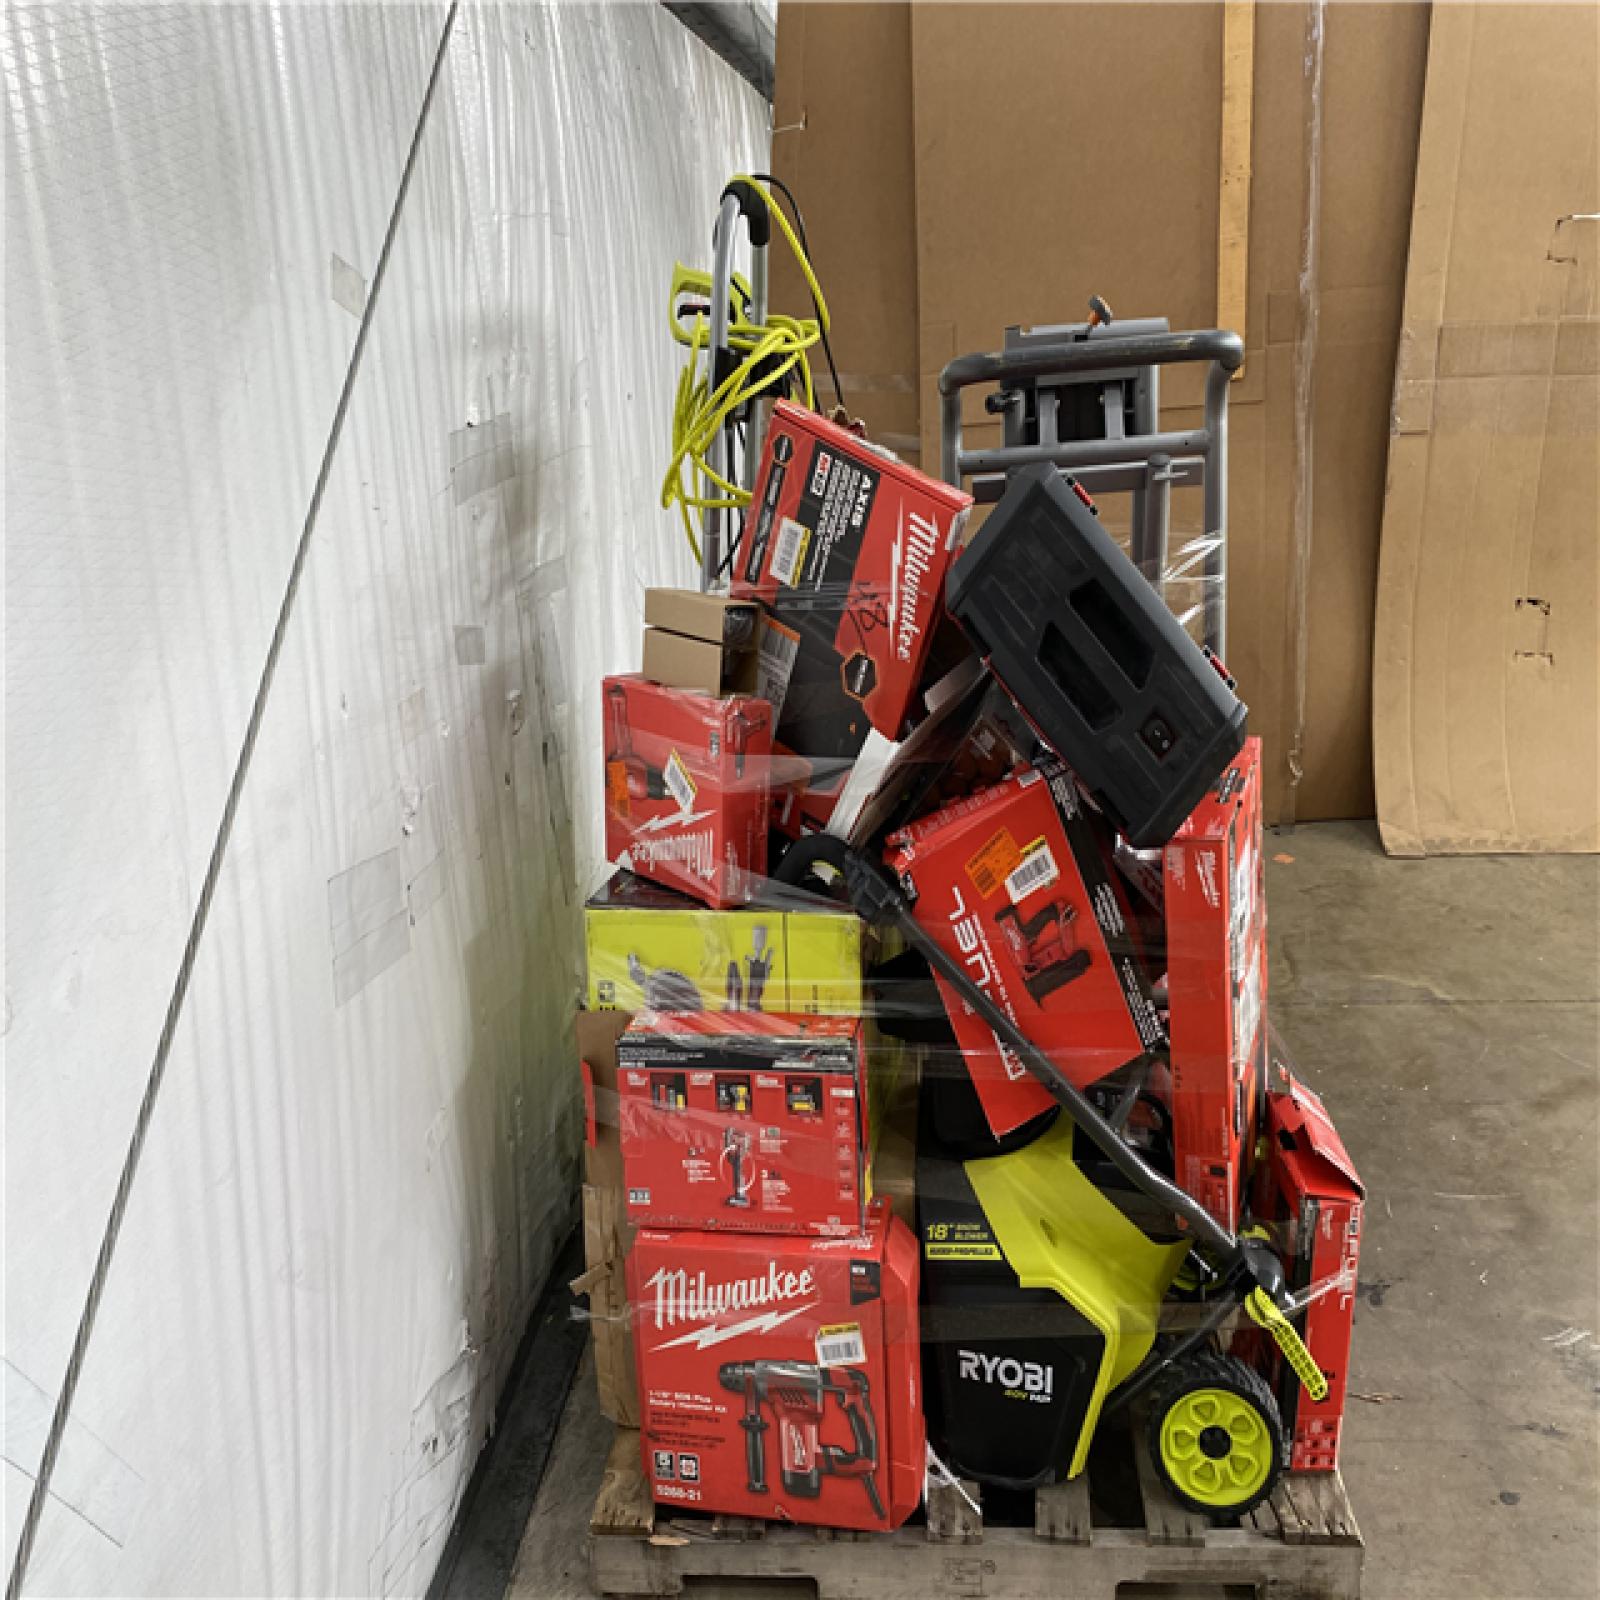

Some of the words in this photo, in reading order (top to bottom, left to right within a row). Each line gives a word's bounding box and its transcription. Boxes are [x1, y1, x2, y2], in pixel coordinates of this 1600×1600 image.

[851, 474, 871, 527] AXIS
[898, 511, 941, 663] Milwaukee
[629, 827, 716, 881] Milwaukee
[643, 1260, 814, 1330] Milwaukee
[957, 1349, 1054, 1395] RYOBI
